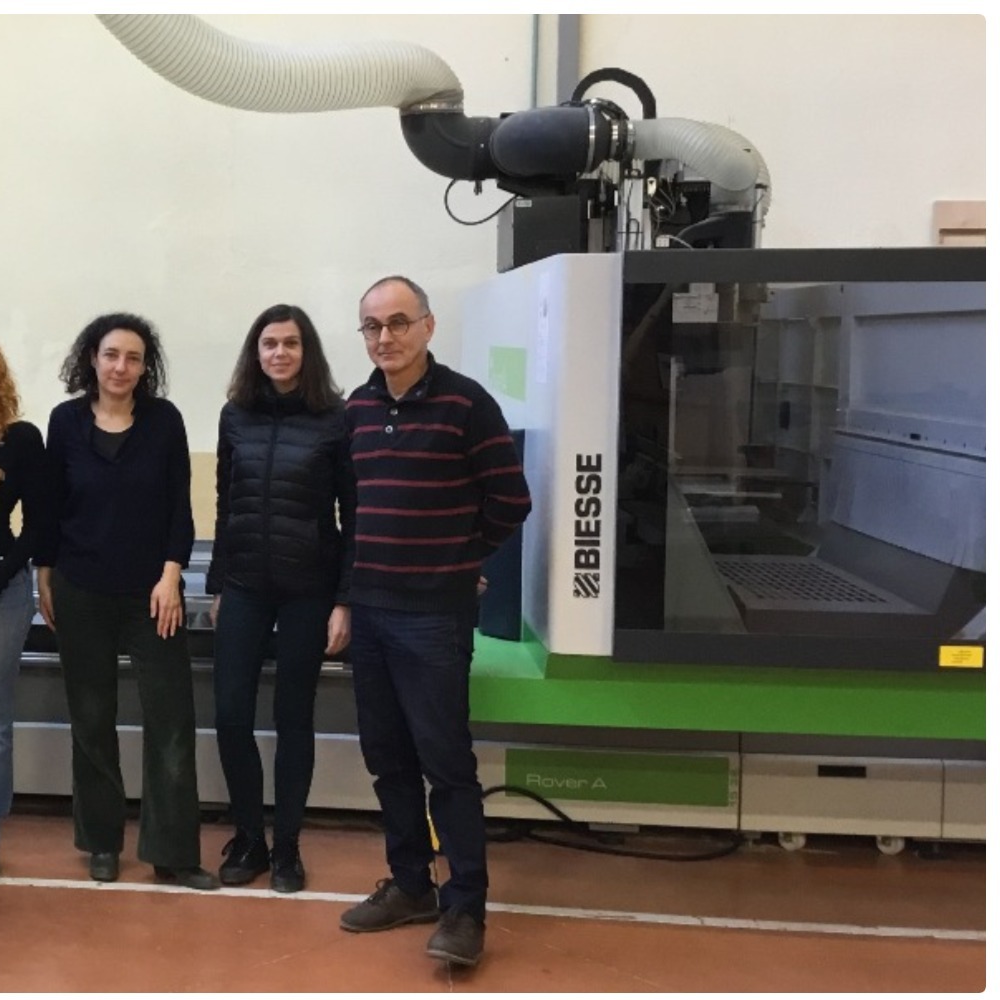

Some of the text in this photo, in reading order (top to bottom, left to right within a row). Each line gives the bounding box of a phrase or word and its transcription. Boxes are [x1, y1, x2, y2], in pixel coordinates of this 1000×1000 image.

[574, 453, 602, 570] BIESSE
[526, 773, 607, 789] Rover A
